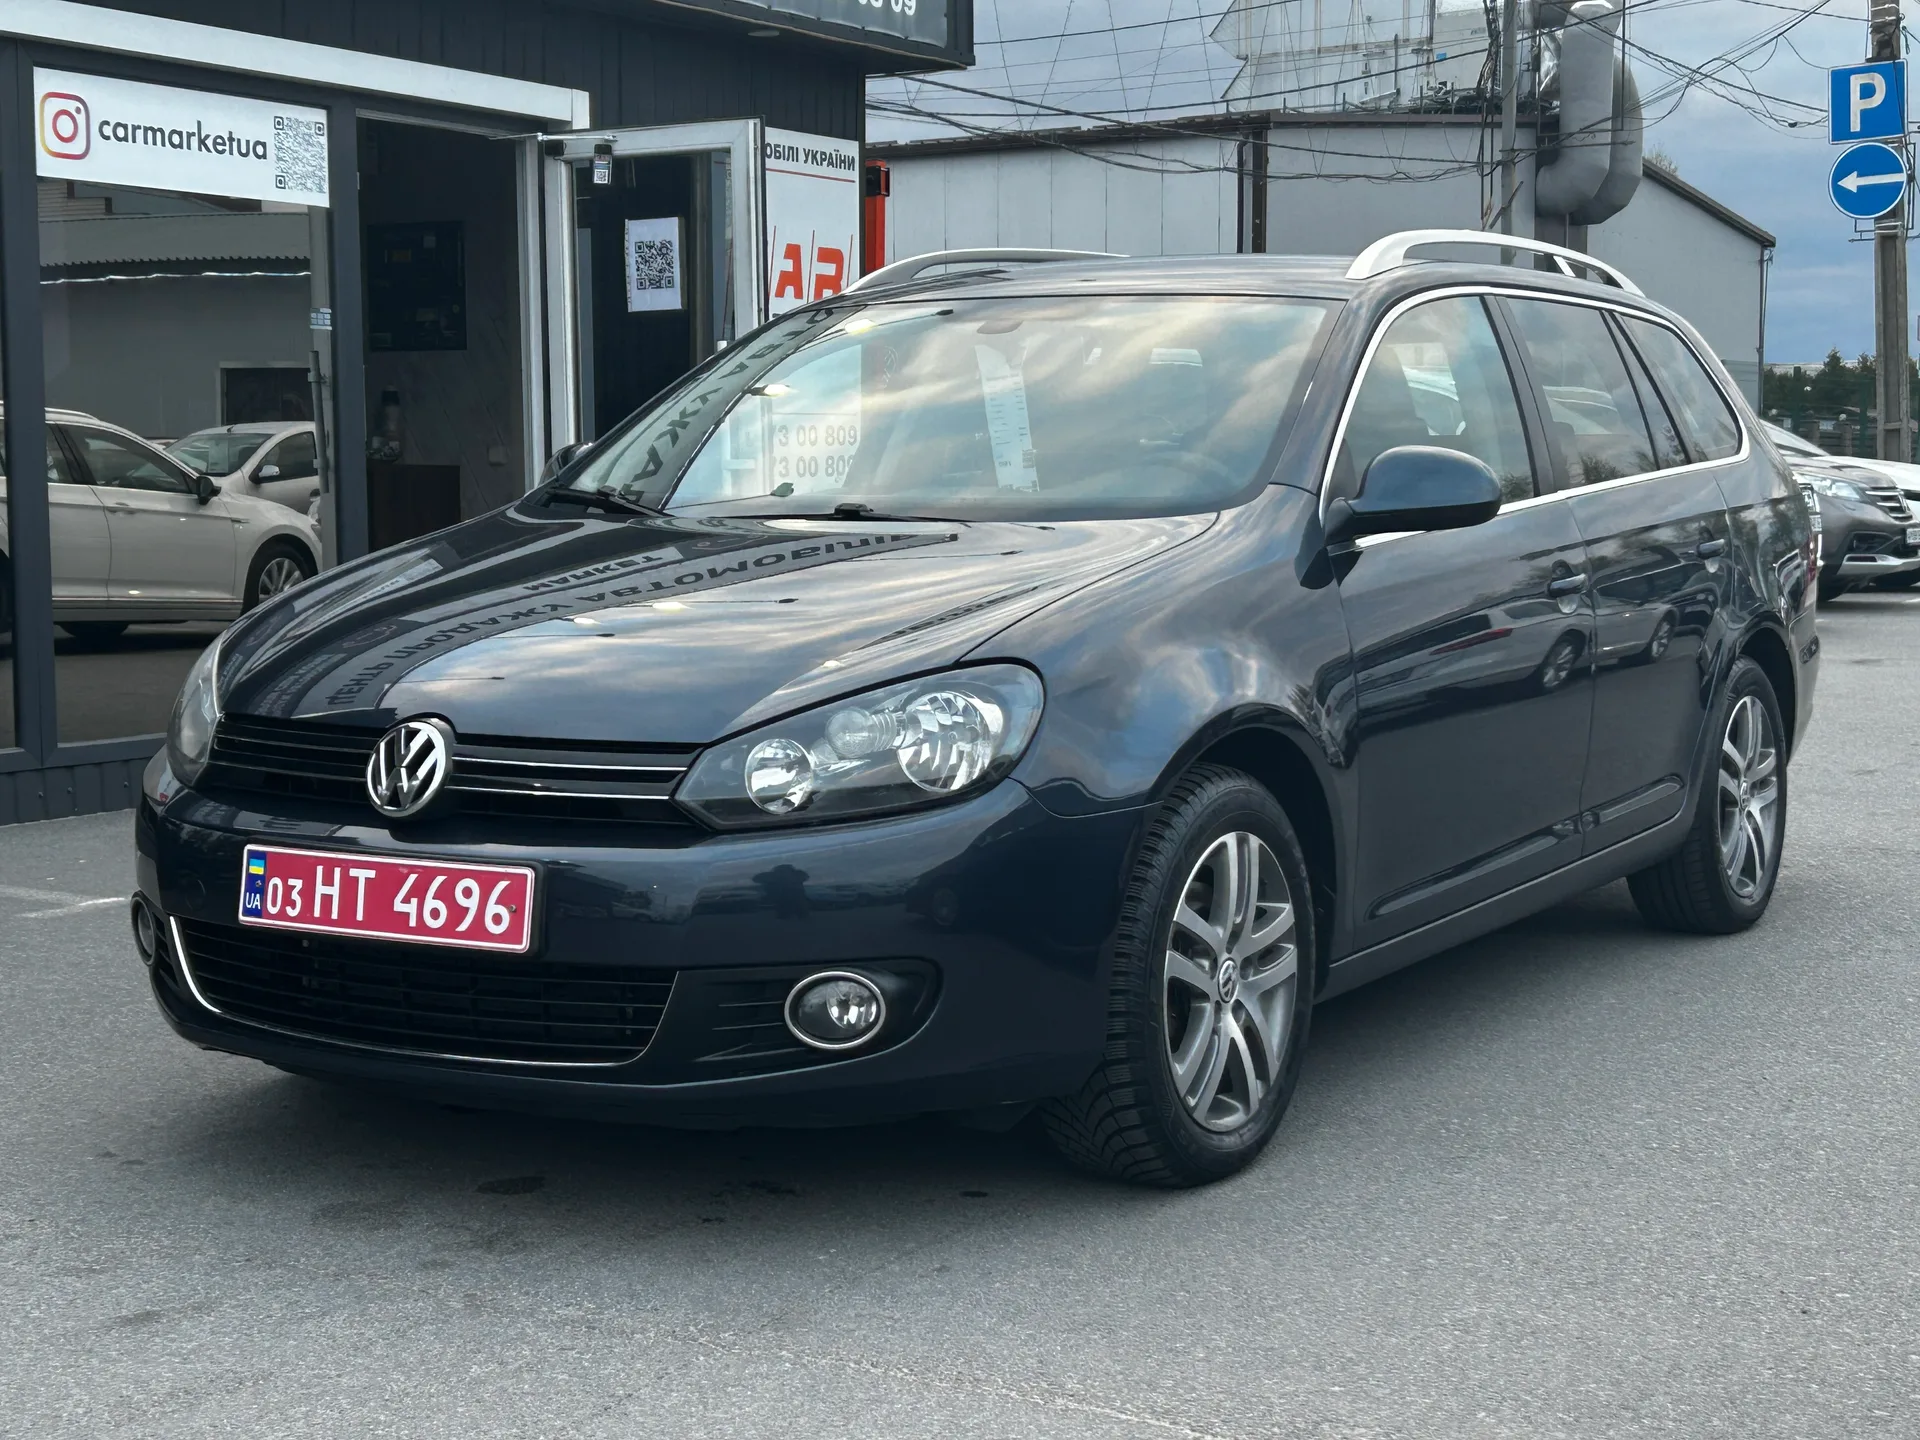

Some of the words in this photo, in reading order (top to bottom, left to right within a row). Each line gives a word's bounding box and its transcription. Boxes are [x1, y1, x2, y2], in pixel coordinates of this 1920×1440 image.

[1850, 72, 1886, 132] P
[98, 119, 268, 160] carmarketua
[803, 148, 856, 172] УКРАЇНИ
[796, 425, 818, 447] 00
[825, 425, 858, 447] 809
[796, 455, 819, 478] 00
[245, 892, 261, 909] UA
[266, 877, 303, 917] 03
[313, 865, 376, 921] HT
[393, 873, 511, 934] 4696
